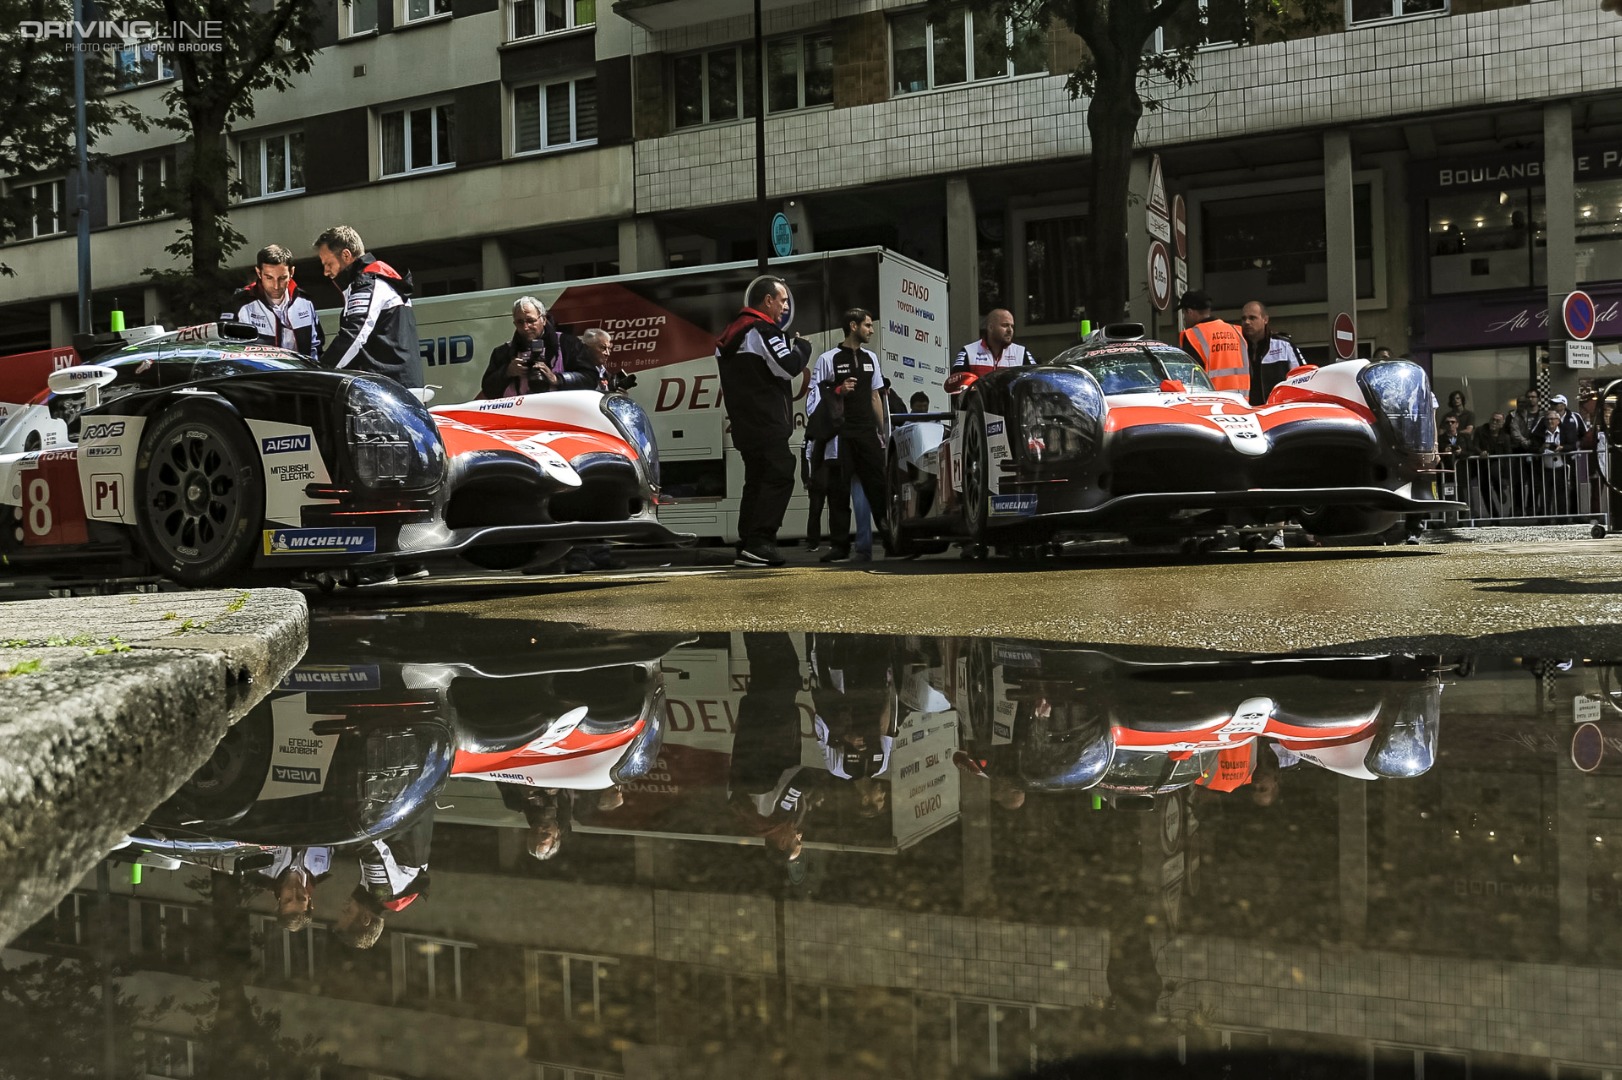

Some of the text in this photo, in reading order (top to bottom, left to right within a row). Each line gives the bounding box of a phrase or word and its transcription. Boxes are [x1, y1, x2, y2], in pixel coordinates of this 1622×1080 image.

[901, 278, 928, 302] DENSO
[897, 299, 935, 321] TOYOTA HYBRID
[604, 315, 667, 330] TOYOTA
[914, 328, 929, 343] ZENT
[1212, 332, 1236, 341] ACCUEIL
[418, 335, 474, 367] RID
[1211, 343, 1239, 353] CONTROLE
[69, 371, 93, 380] Mobil
[479, 402, 514, 411] HYBRID
[82, 422, 125, 440] RAYS
[266, 438, 307, 452] AISIN
[42, 451, 78, 461] TOTAL
[270, 463, 309, 475] MITSUBISHI
[280, 471, 315, 482] ELECTRIC
[95, 481, 119, 511] P1
[28, 478, 53, 536] 8
[995, 501, 1029, 510] MICHELIN
[290, 536, 364, 547] MICHELIN
